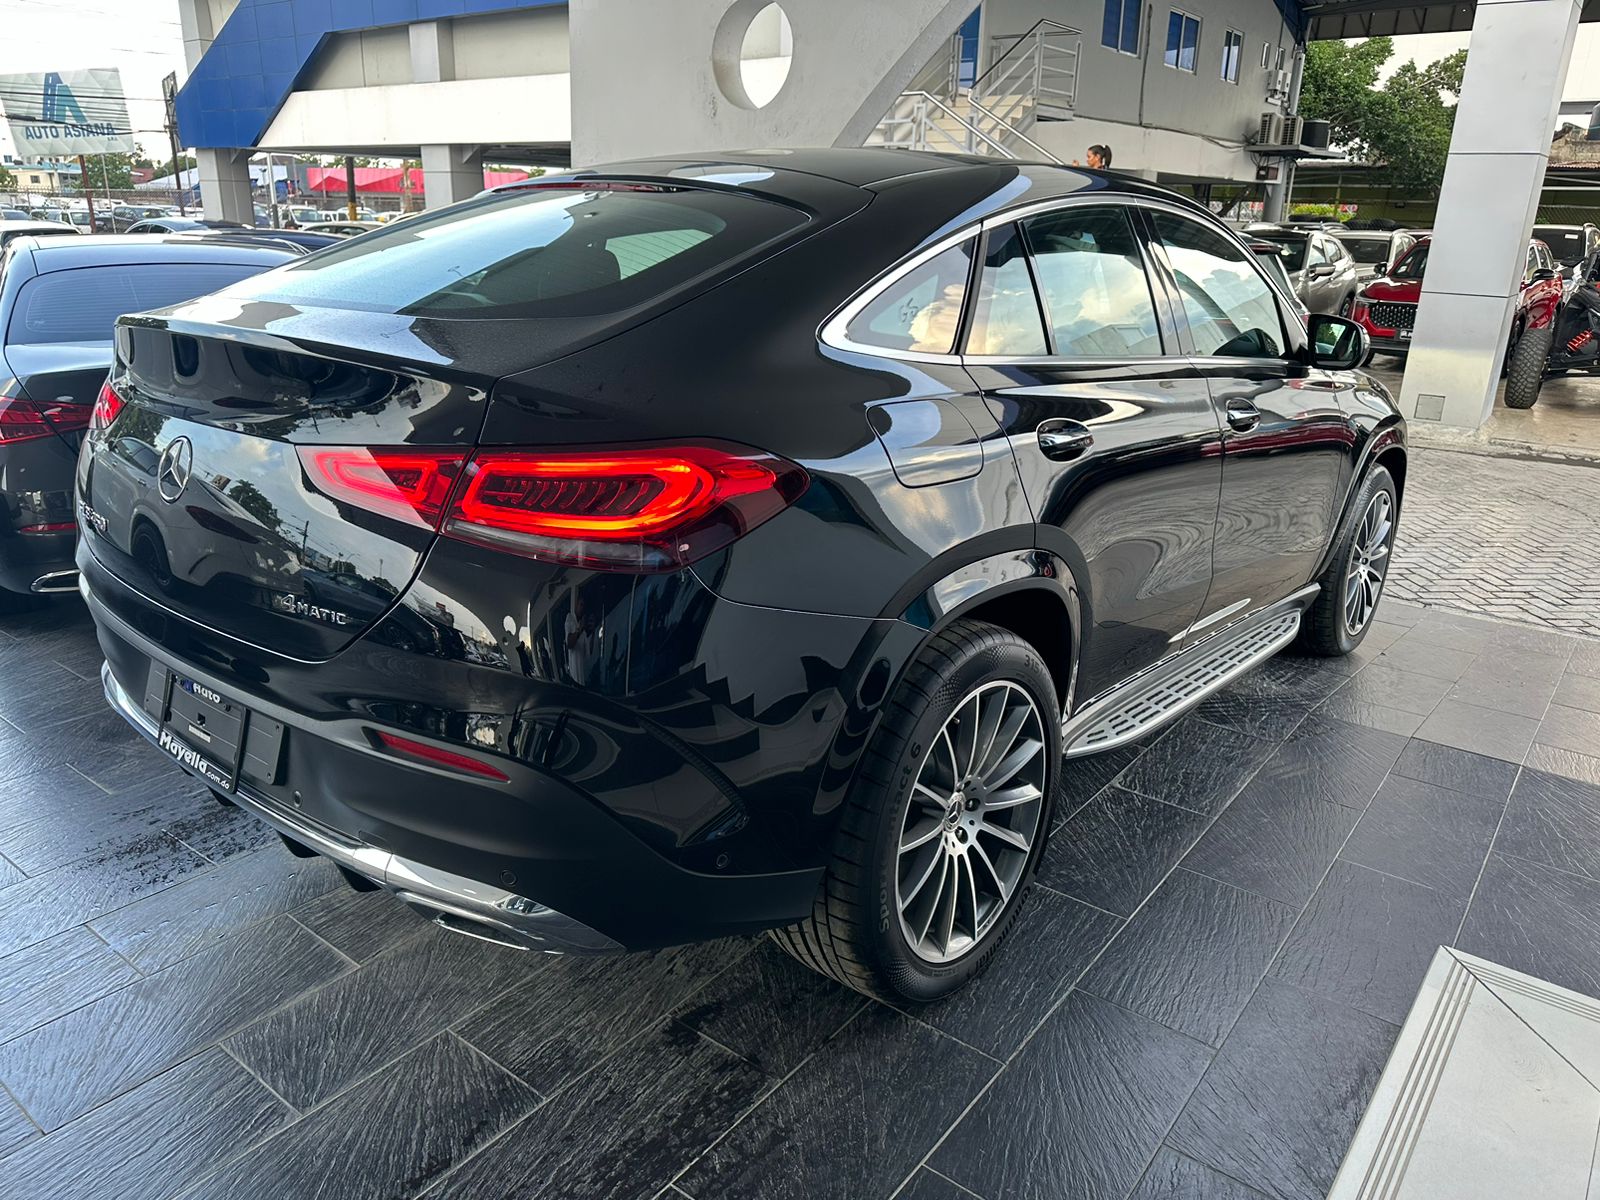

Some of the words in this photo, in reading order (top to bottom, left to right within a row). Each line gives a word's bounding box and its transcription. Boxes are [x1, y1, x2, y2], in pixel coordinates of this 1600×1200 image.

[25, 125, 60, 140] AUTO
[64, 122, 115, 138] ASIANA
[281, 594, 346, 625] 4MATIC
[193, 682, 221, 704] Auto
